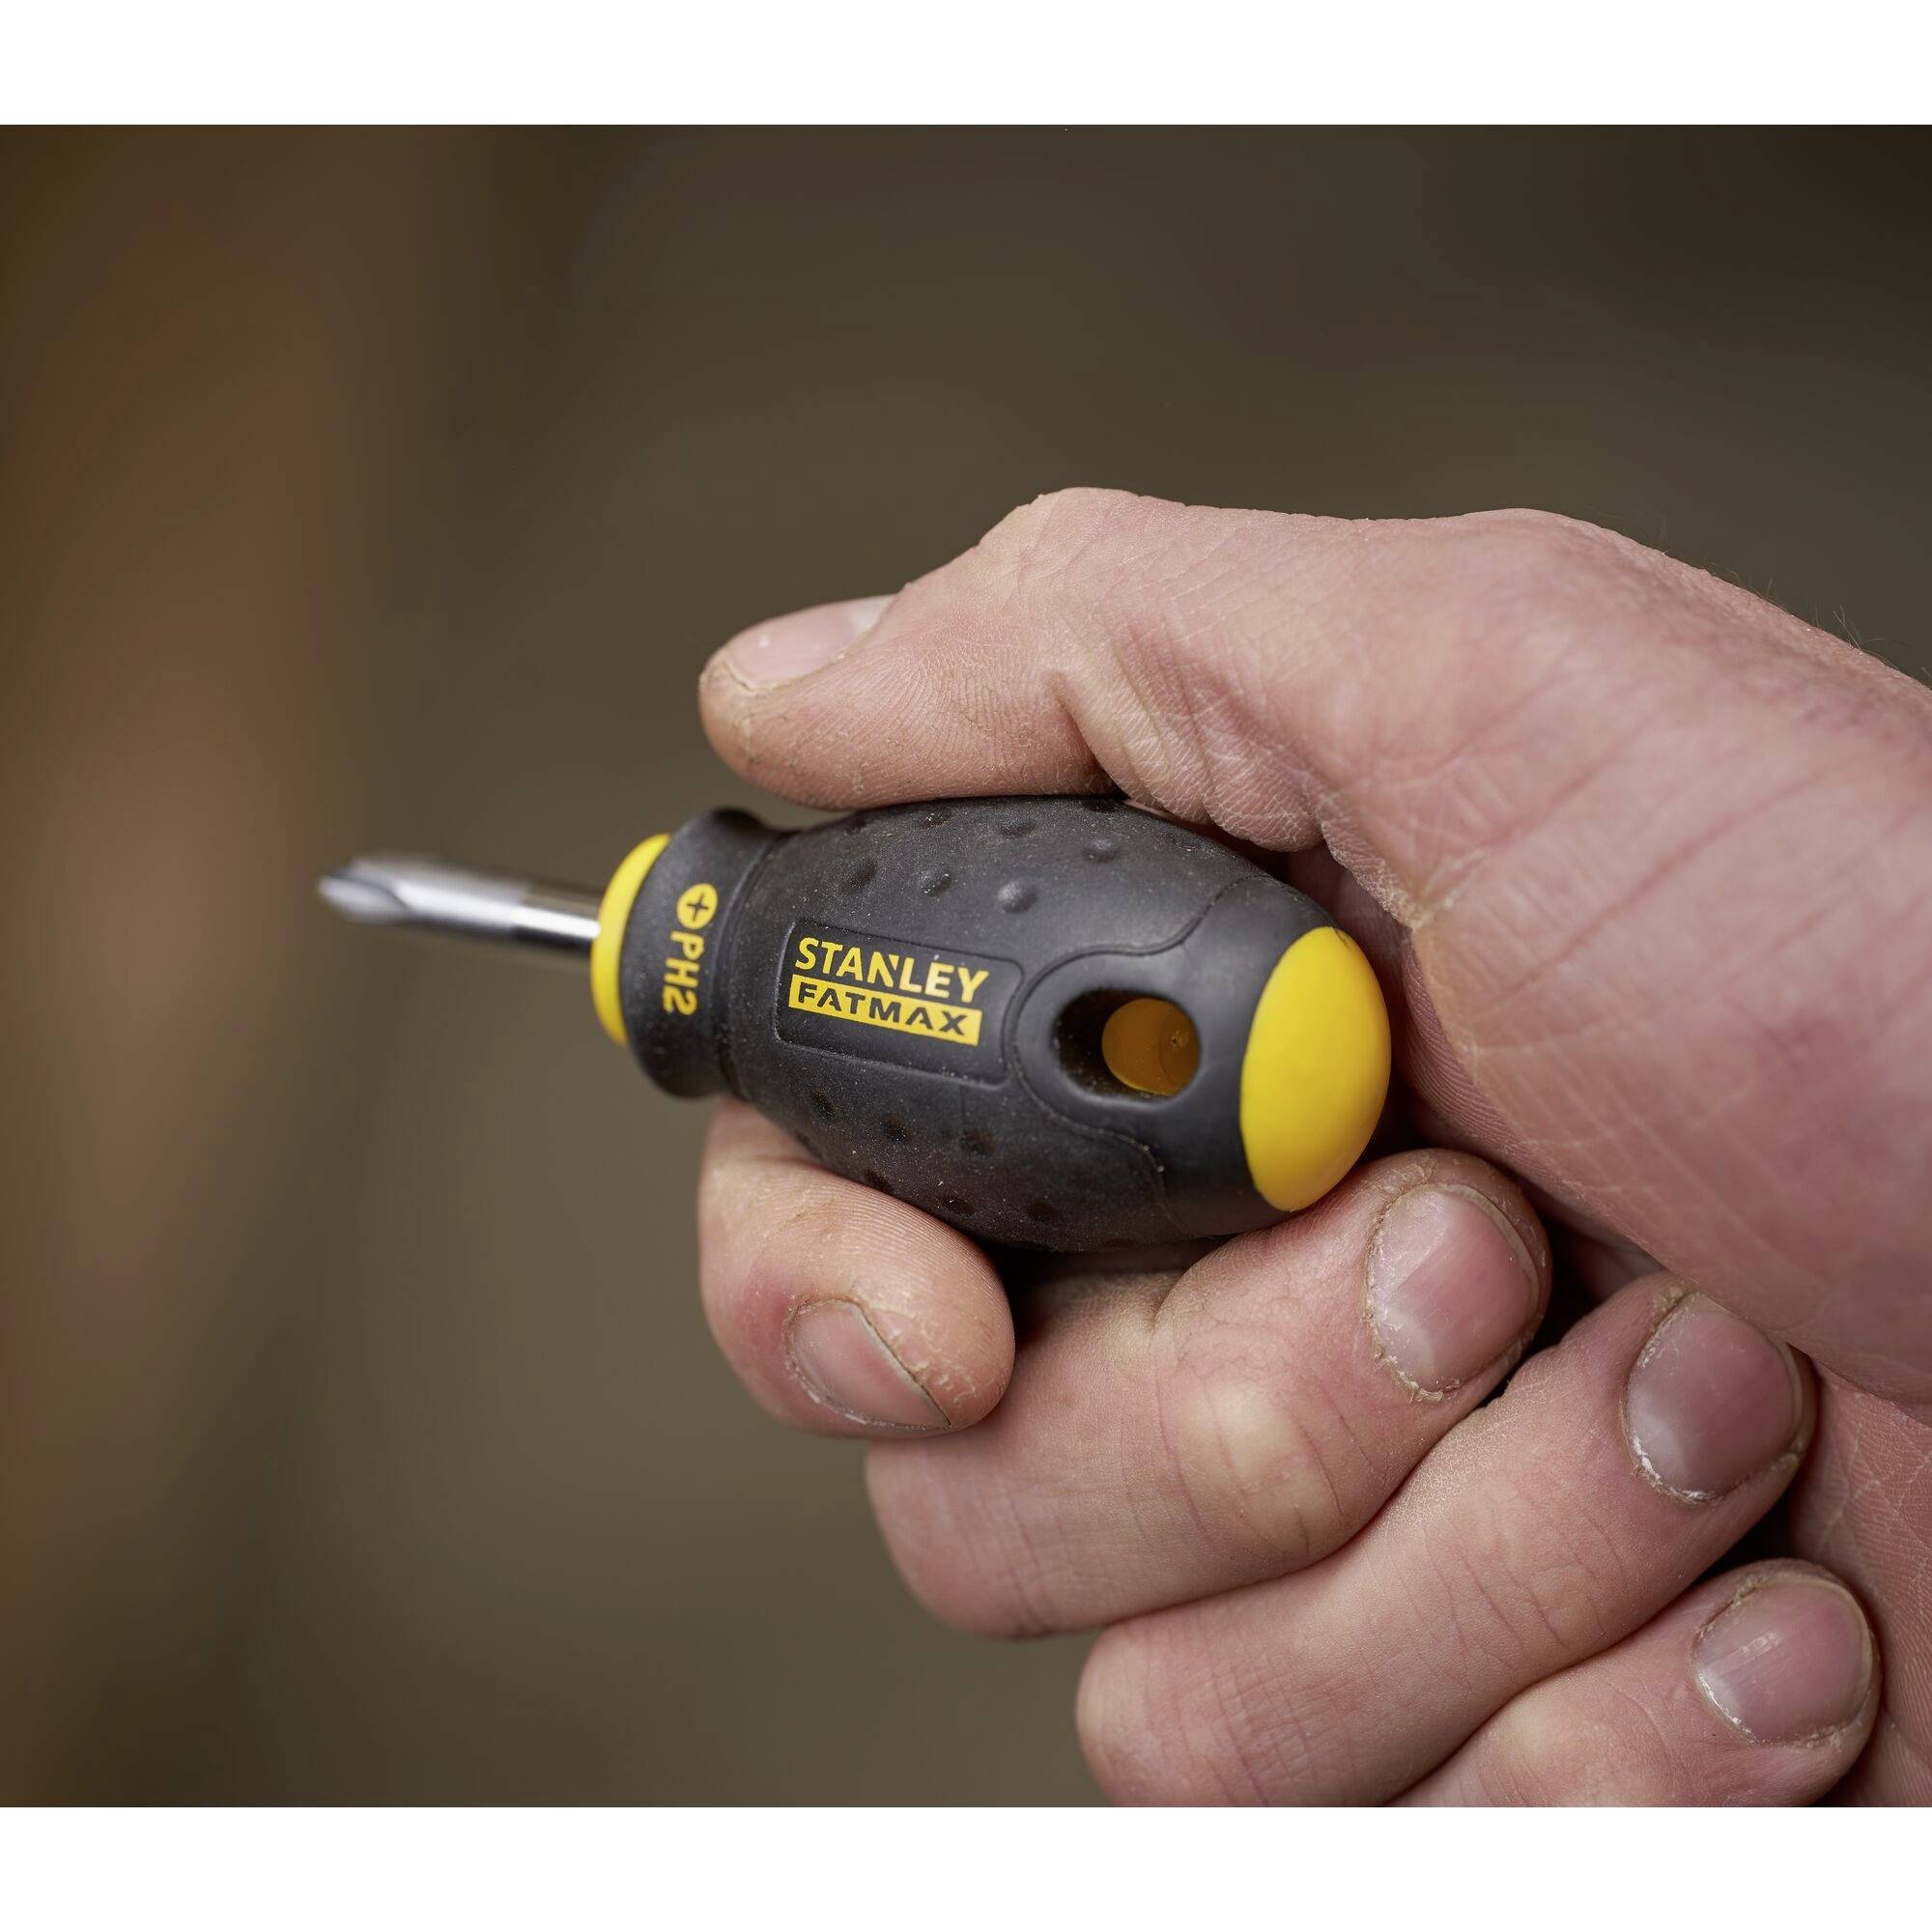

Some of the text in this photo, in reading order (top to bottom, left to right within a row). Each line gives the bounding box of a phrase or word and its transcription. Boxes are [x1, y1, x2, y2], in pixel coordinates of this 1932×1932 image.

[663, 931, 704, 1015] PH2
[795, 937, 989, 1003] STANLEY
[797, 981, 967, 1037] FATMAX
